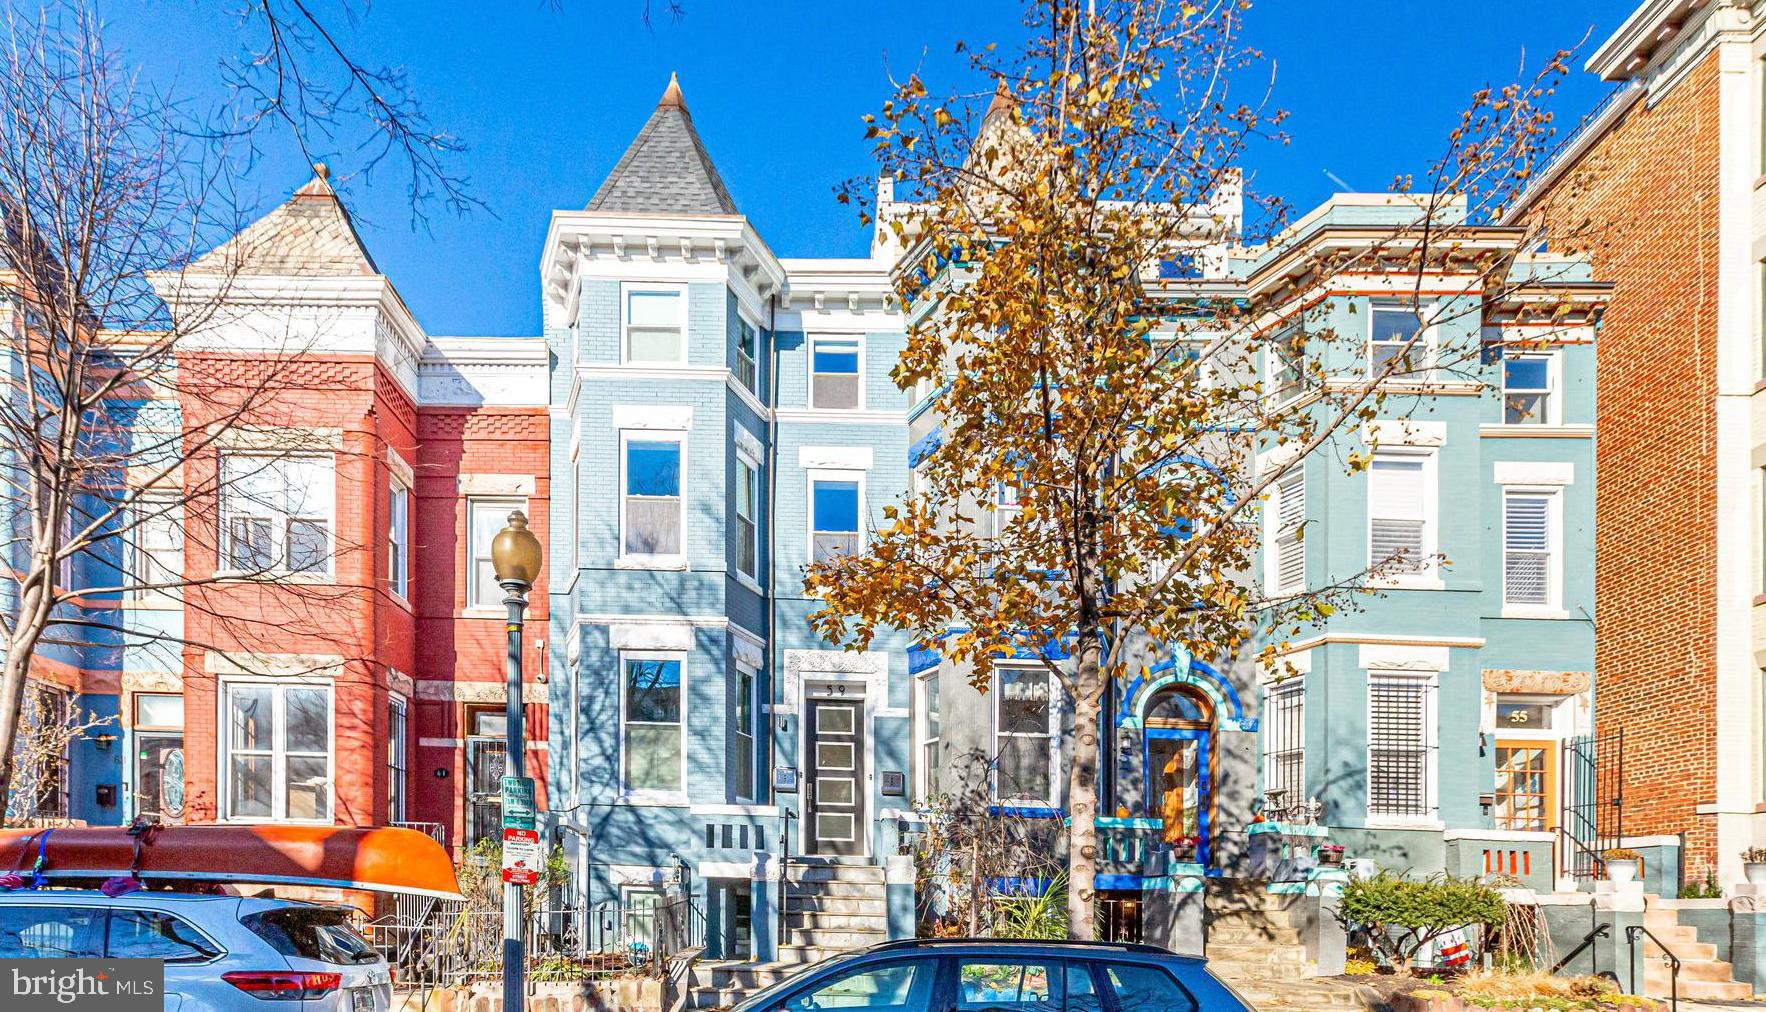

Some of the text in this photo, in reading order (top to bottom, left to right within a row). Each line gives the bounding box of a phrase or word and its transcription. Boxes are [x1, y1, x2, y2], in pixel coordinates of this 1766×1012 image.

[826, 685, 845, 696] 59
[1511, 710, 1528, 723] 55
[507, 835, 535, 843] PARKING
